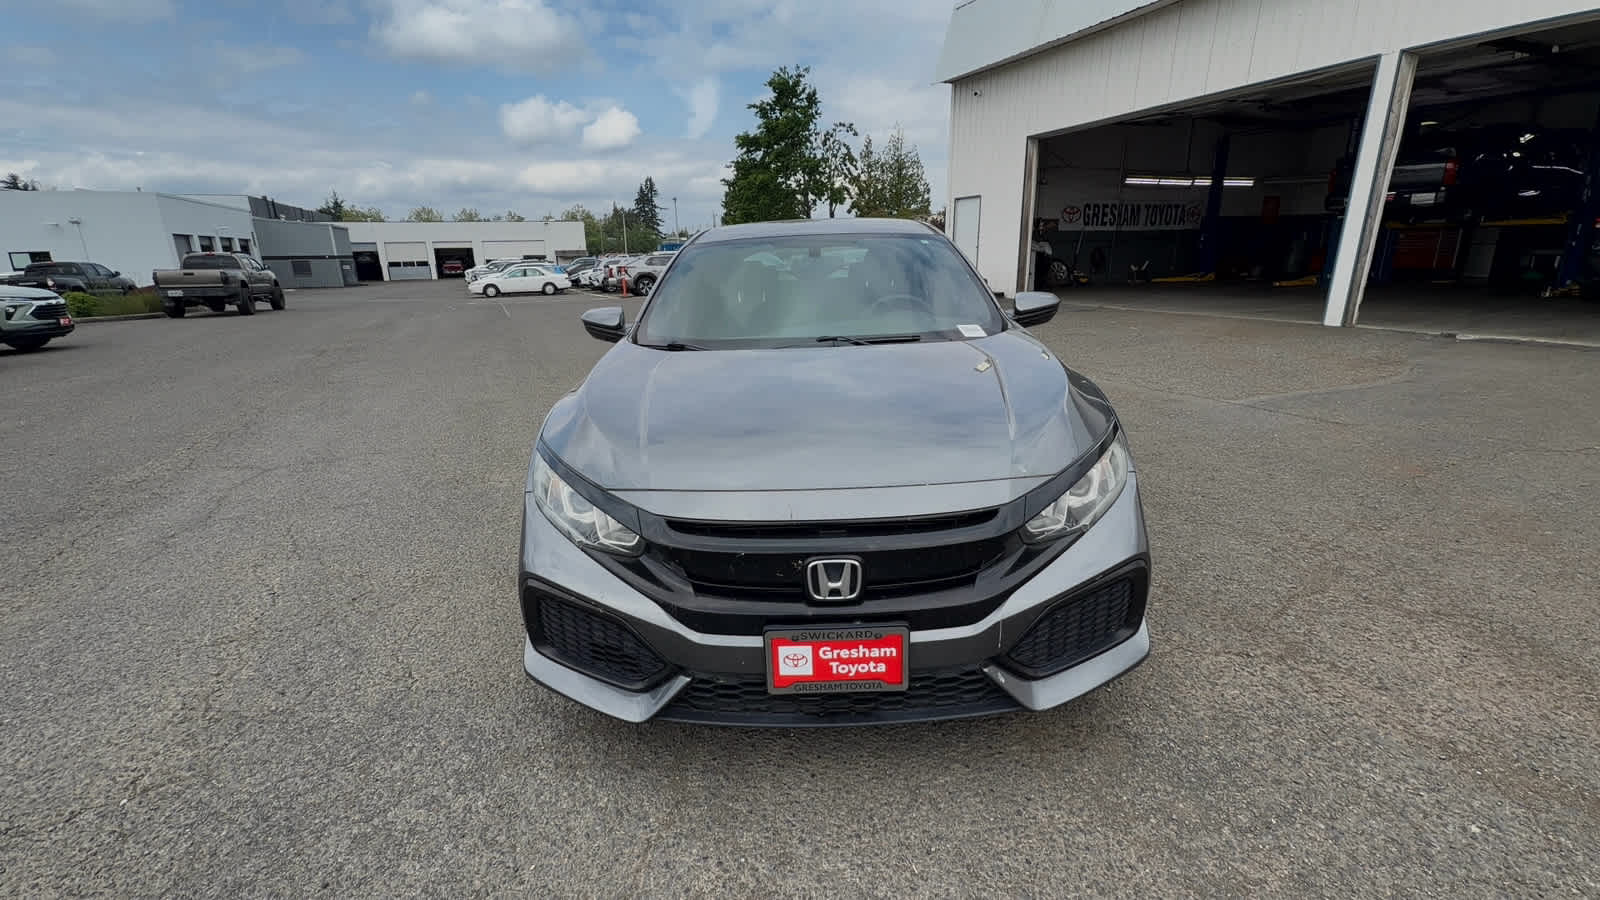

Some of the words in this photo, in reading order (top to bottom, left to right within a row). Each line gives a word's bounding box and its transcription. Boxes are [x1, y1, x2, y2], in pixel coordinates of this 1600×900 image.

[1083, 203, 1140, 227] GRESHAM
[1144, 203, 1186, 226] TOYOTA
[800, 630, 873, 641] SWICKARD
[819, 645, 896, 659] Gresham
[829, 661, 886, 676] Toyota
[793, 682, 843, 692] GRESHAM
[845, 681, 883, 691] TOYOTA
